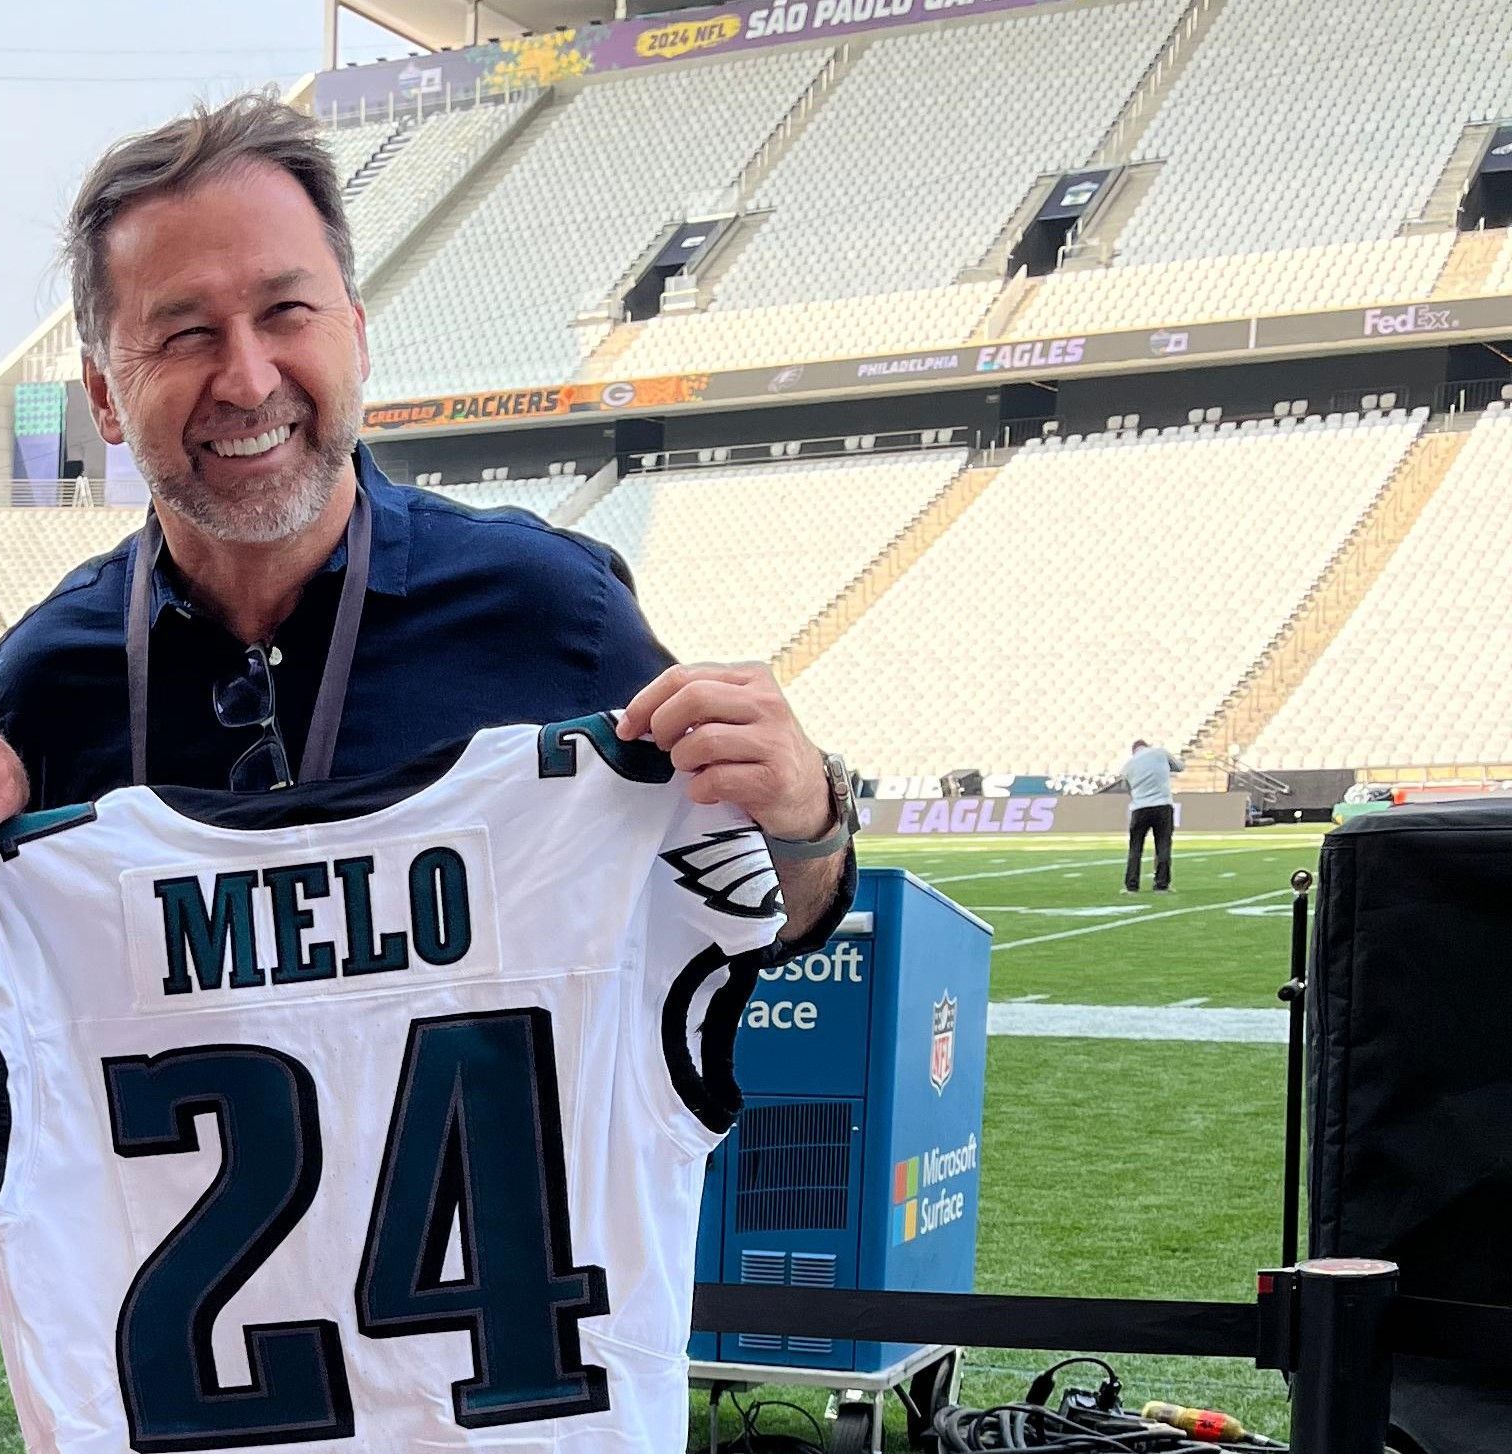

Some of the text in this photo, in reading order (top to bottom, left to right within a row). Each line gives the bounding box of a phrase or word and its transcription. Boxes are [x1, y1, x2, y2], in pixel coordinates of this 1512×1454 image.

[648, 23, 727, 50] 2024 NFL
[745, 0, 809, 39] SÃO
[1363, 304, 1451, 335] FedEx
[857, 338, 1086, 377] PHILADELPHIA EAGLES
[450, 389, 558, 420] PACKERS
[896, 798, 1058, 833] EAGLES
[153, 846, 473, 995] MELO
[922, 1132, 978, 1187] Microsoft
[101, 1006, 611, 1454] 24
[920, 1188, 964, 1235] Surface
